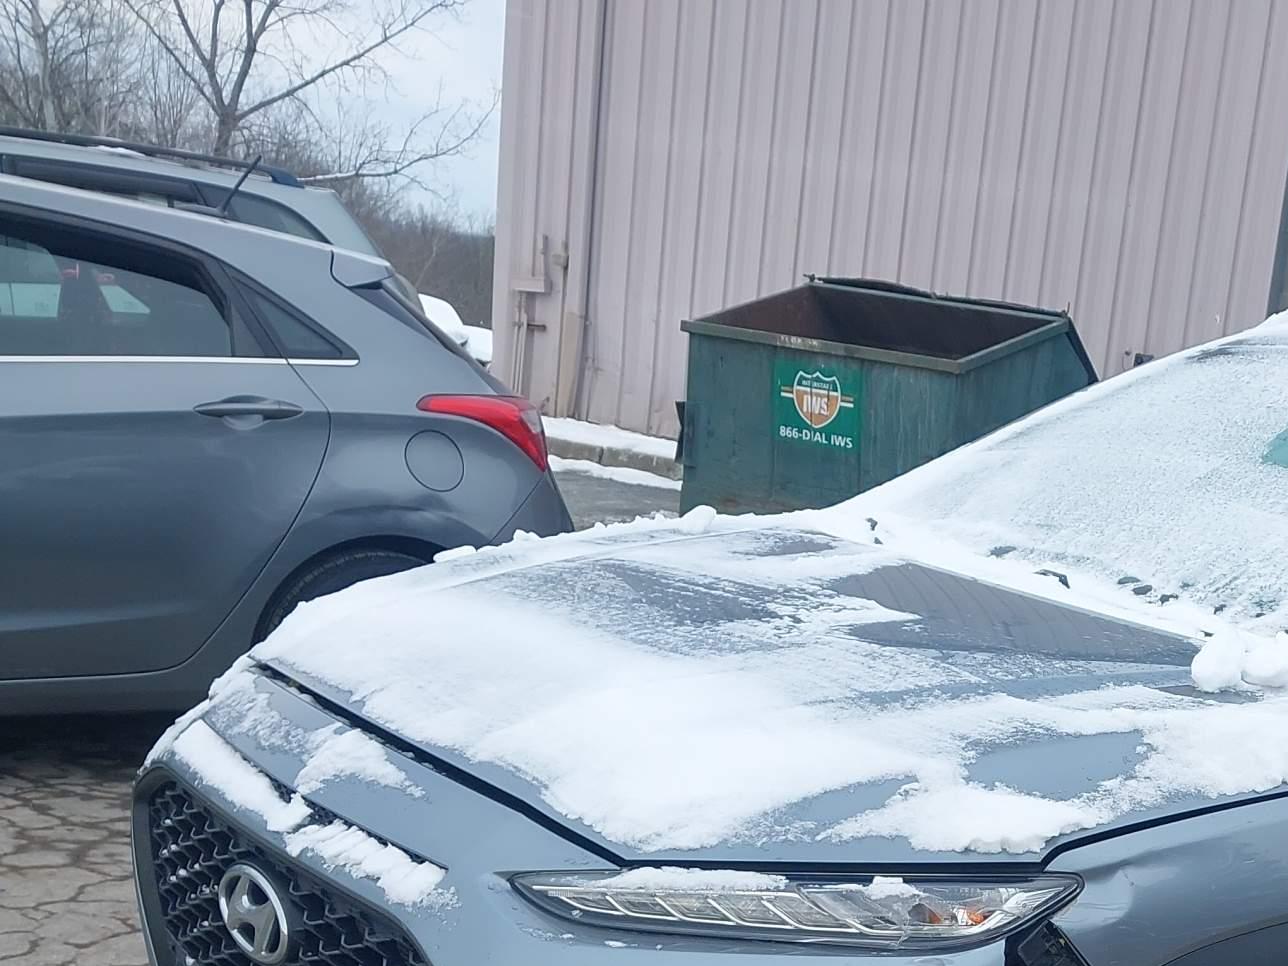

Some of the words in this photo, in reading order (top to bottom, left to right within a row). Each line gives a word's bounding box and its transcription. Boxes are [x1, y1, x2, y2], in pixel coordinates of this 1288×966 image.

[803, 394, 828, 415] IWS
[779, 425, 828, 444] 866-DIAL
[831, 434, 853, 448] IWS
